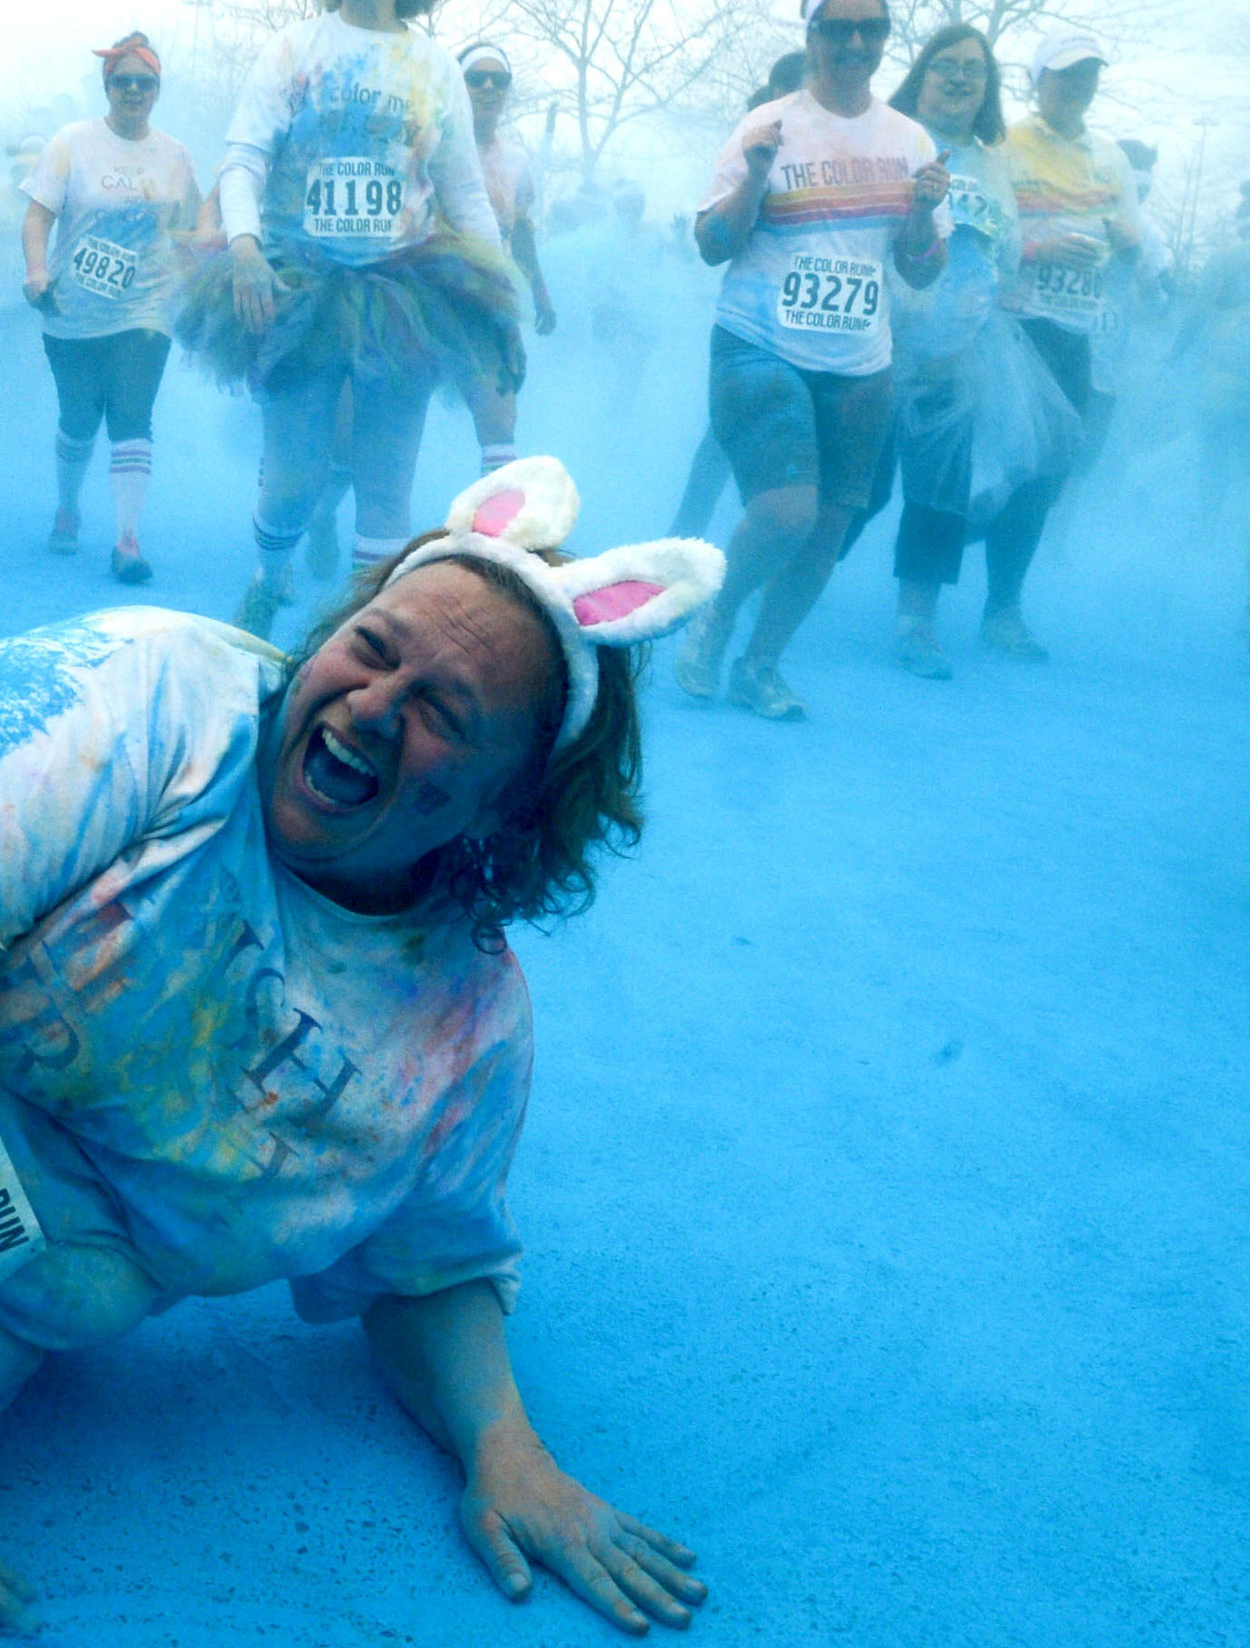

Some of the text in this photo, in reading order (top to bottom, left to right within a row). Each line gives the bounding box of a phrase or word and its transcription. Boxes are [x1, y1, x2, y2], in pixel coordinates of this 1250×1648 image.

[320, 162, 334, 176] THE
[337, 162, 372, 177] COLOR
[780, 156, 908, 190] THE COLOR RUN
[306, 178, 402, 216] 41198
[314, 218, 333, 232] THE
[336, 218, 370, 233] COLOR
[73, 247, 136, 289] 49820
[794, 255, 869, 276] THE COLOR RUN
[781, 271, 879, 316] 93279
[785, 309, 863, 332] THE COLOR RUN
